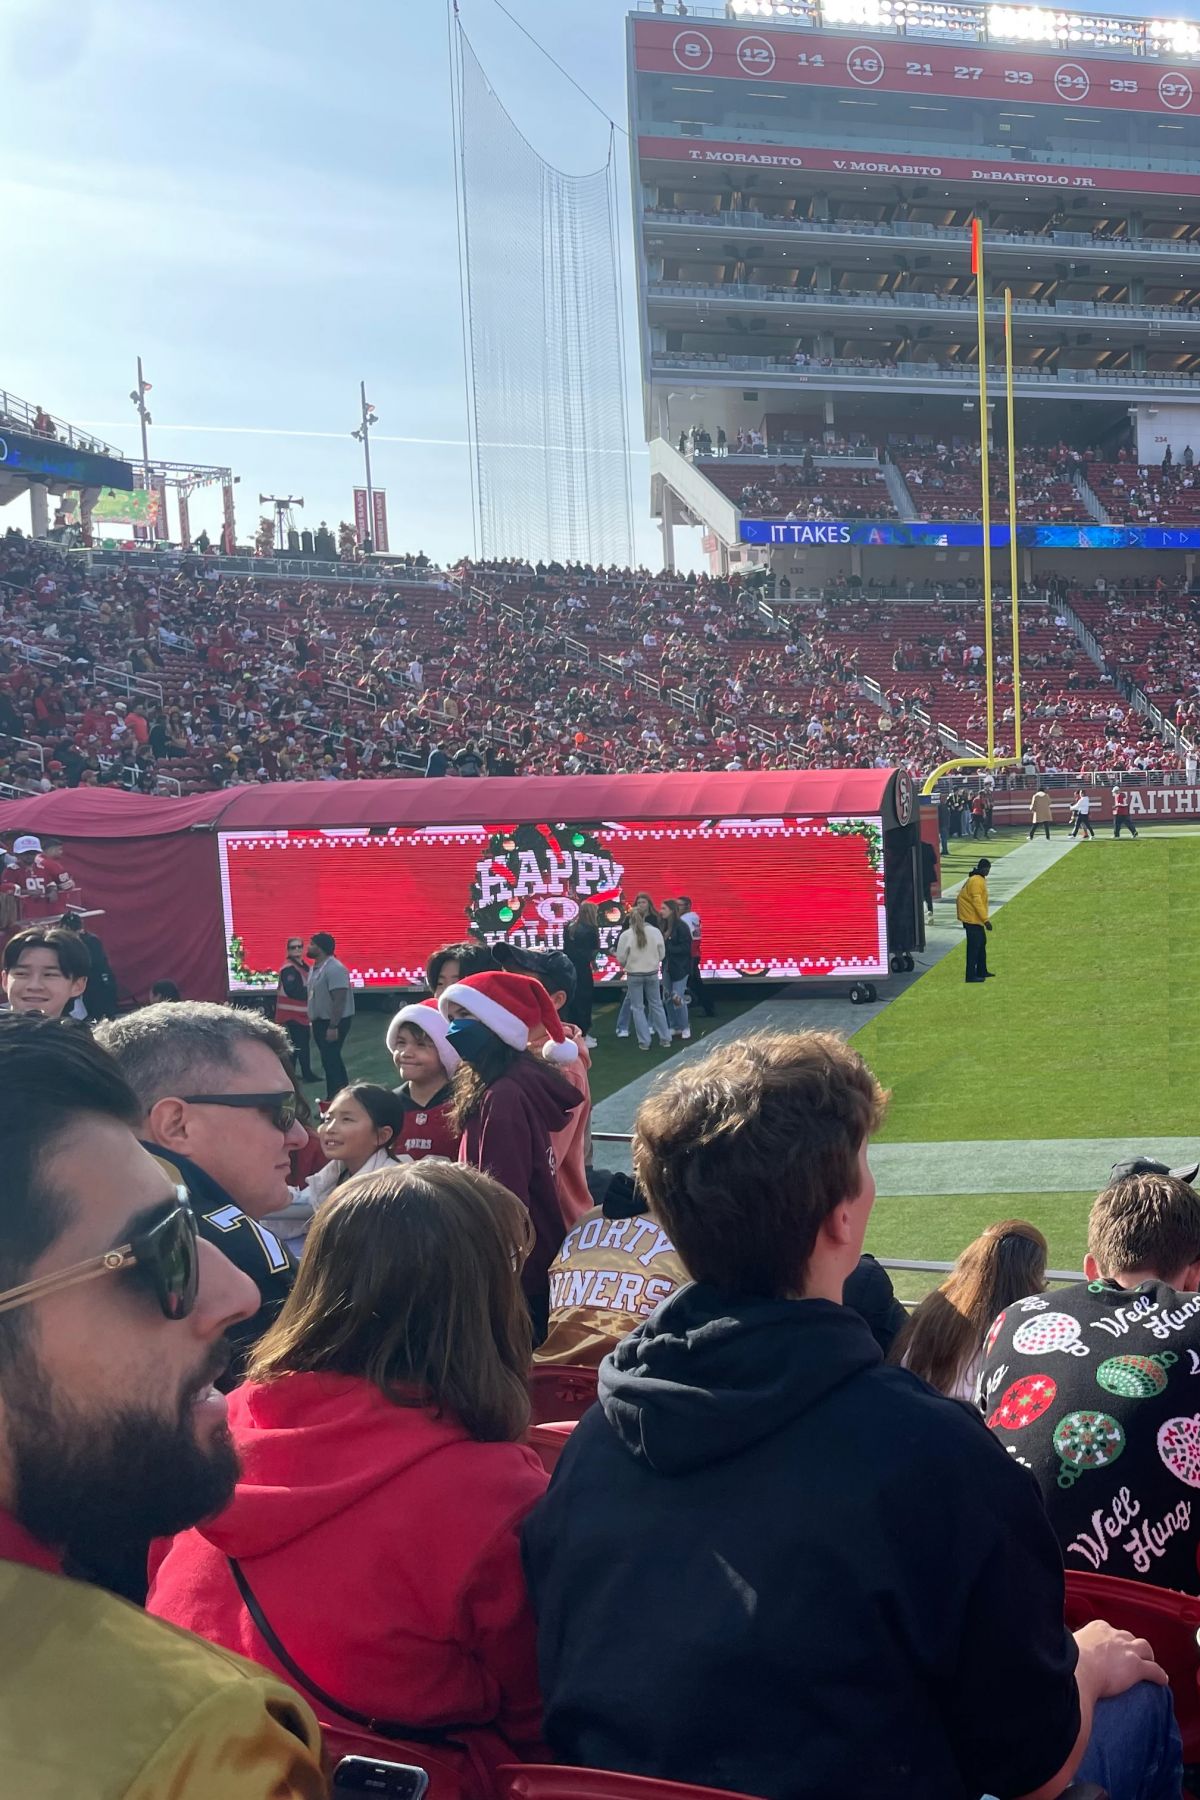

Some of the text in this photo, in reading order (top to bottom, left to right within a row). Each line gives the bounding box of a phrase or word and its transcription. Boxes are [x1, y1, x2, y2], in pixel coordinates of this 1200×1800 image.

[684, 43, 702, 57] 8
[743, 48, 770, 64] 12
[797, 53, 825, 68] 14
[852, 58, 879, 73] 16
[906, 62, 934, 77] 21
[954, 66, 983, 80] 27
[1004, 71, 1033, 85] 33
[1058, 75, 1086, 89] 34
[1110, 79, 1138, 94] 35
[1162, 83, 1188, 97] 37
[689, 149, 802, 167] T. MORABITO
[833, 160, 942, 177] V. MORABITO
[1073, 176, 1096, 188] JR.
[790, 525, 851, 543] TAKES
[477, 849, 624, 909] HAPPY
[560, 1216, 677, 1267] FORTY
[1090, 1295, 1159, 1338] Well
[1067, 1486, 1140, 1569] Well
[1123, 1500, 1192, 1573] Hung
